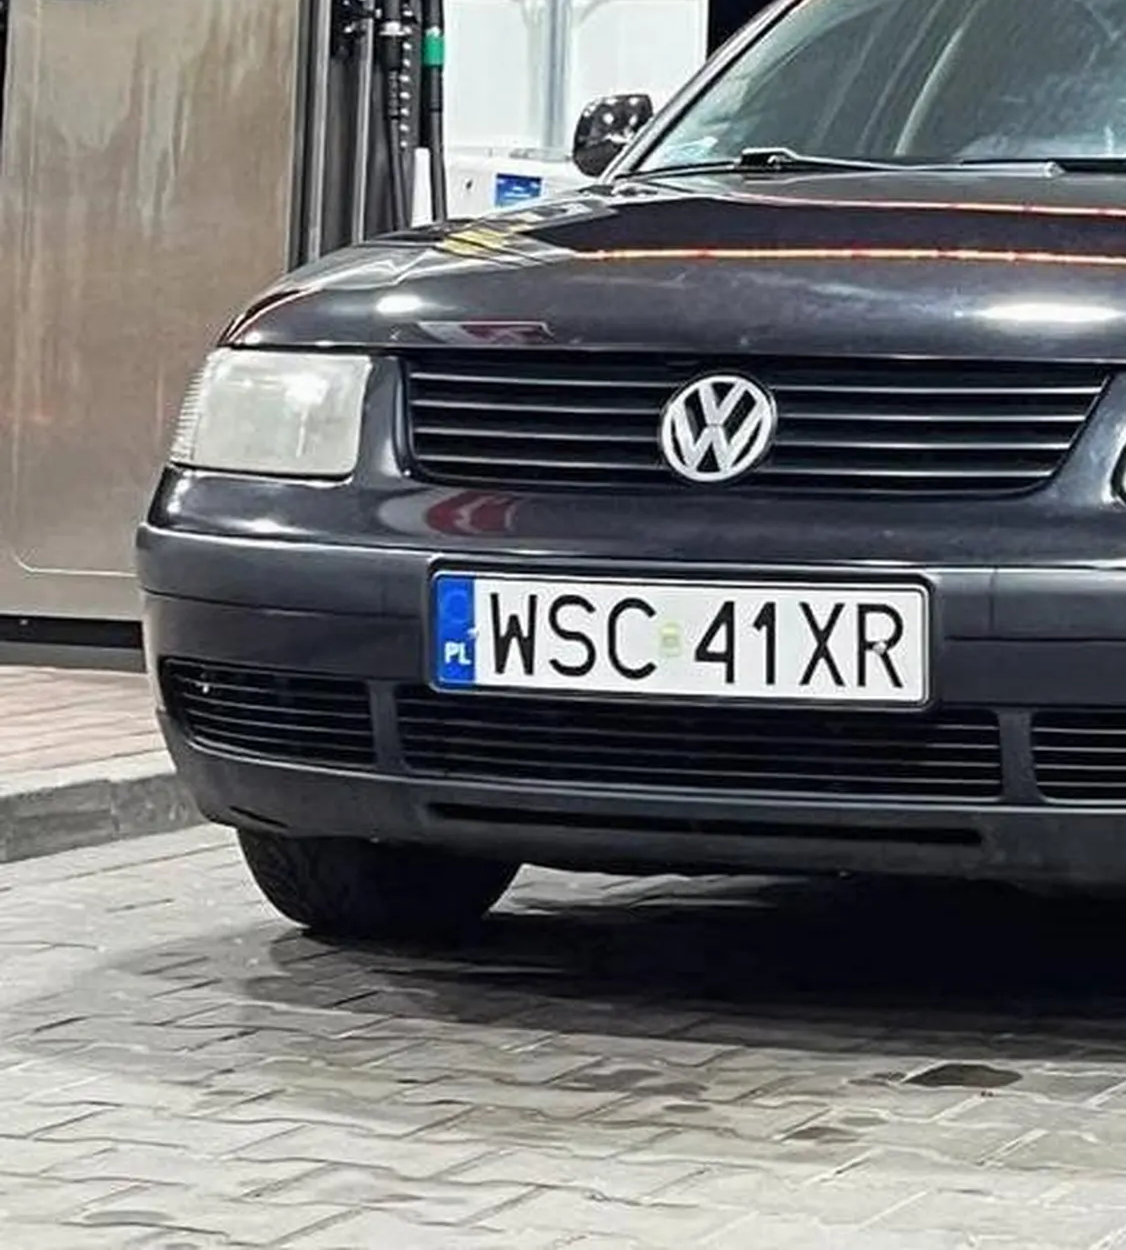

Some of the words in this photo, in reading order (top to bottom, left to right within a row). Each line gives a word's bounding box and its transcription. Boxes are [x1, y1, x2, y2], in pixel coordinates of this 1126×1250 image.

[663, 376, 772, 481] VW
[444, 641, 472, 665] PL
[490, 592, 657, 680] WSC
[694, 601, 904, 688] 41XR
